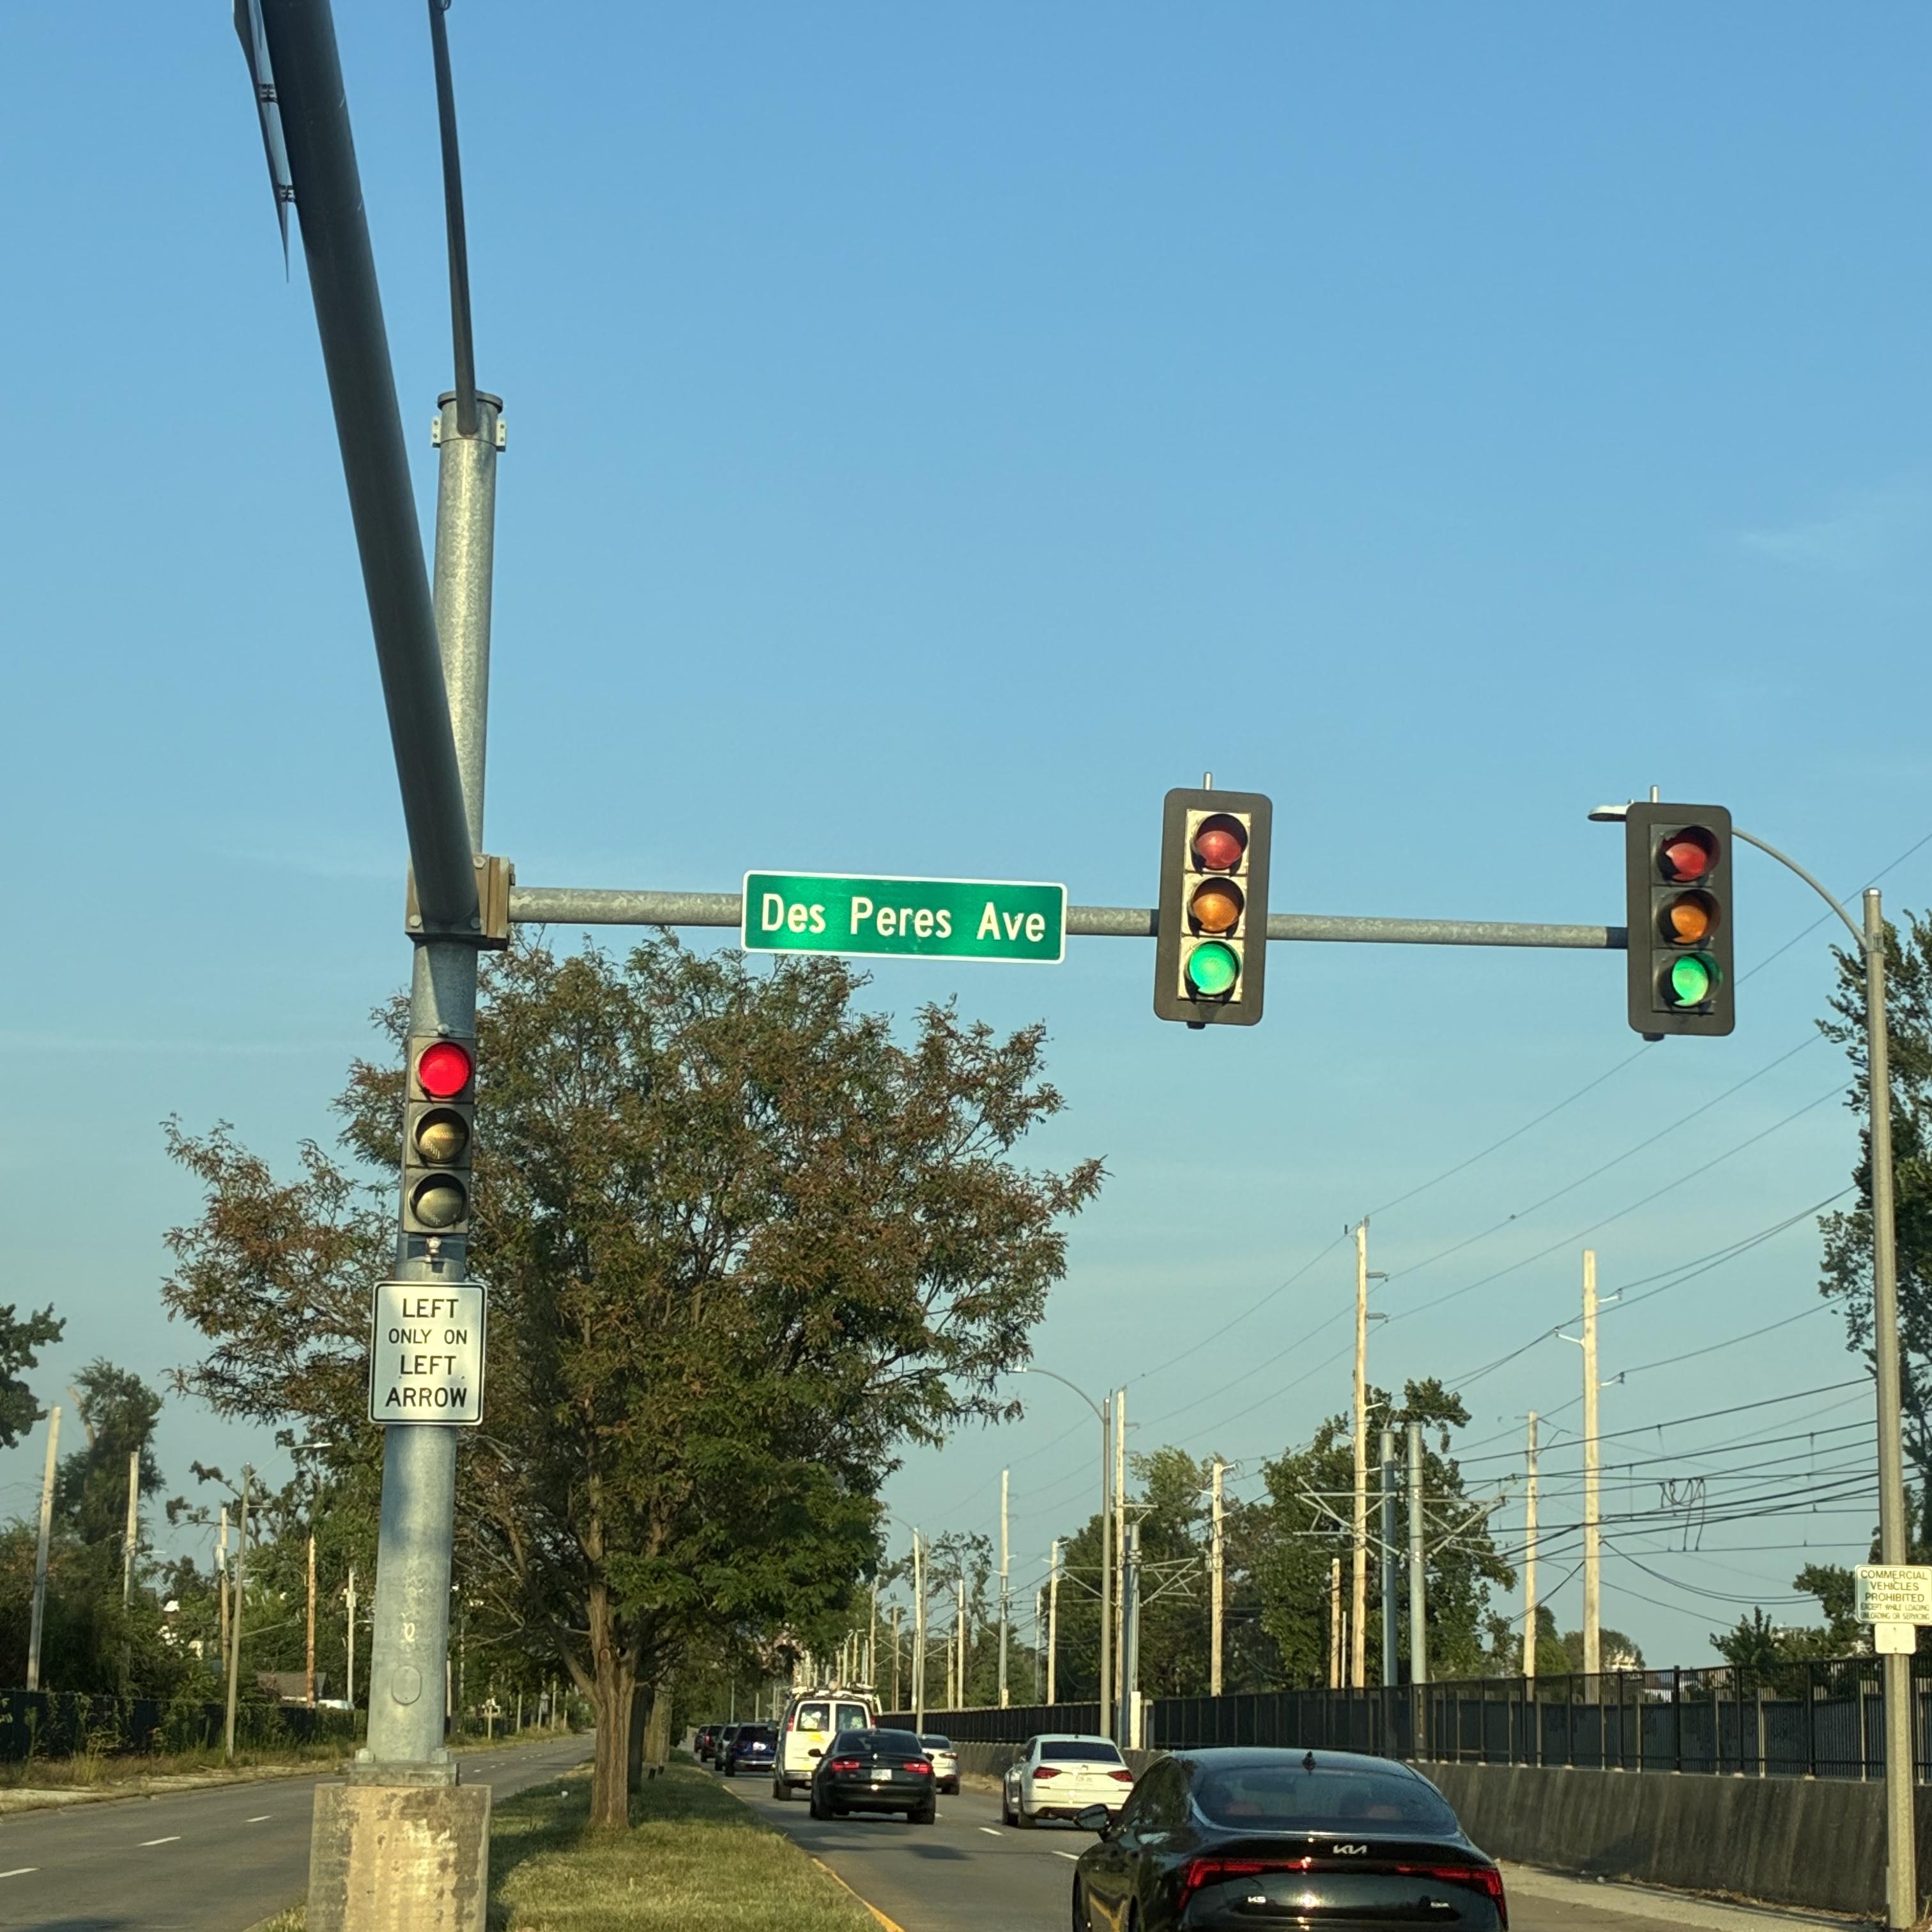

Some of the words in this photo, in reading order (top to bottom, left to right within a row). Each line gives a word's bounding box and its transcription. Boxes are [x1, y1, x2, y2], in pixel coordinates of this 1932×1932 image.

[762, 893, 826, 933] Des
[850, 896, 952, 939] Peres
[976, 901, 1046, 942] Ave
[402, 1298, 459, 1318] LEFT
[388, 1328, 433, 1344] ONLY
[444, 1330, 467, 1344] ON
[400, 1354, 456, 1375] LEFT
[385, 1386, 467, 1407] ARROW
[1860, 1570, 1928, 1580] COMMERCIAL
[1870, 1581, 1919, 1591] VEHICLES
[1865, 1592, 1924, 1602] PROHIBITED
